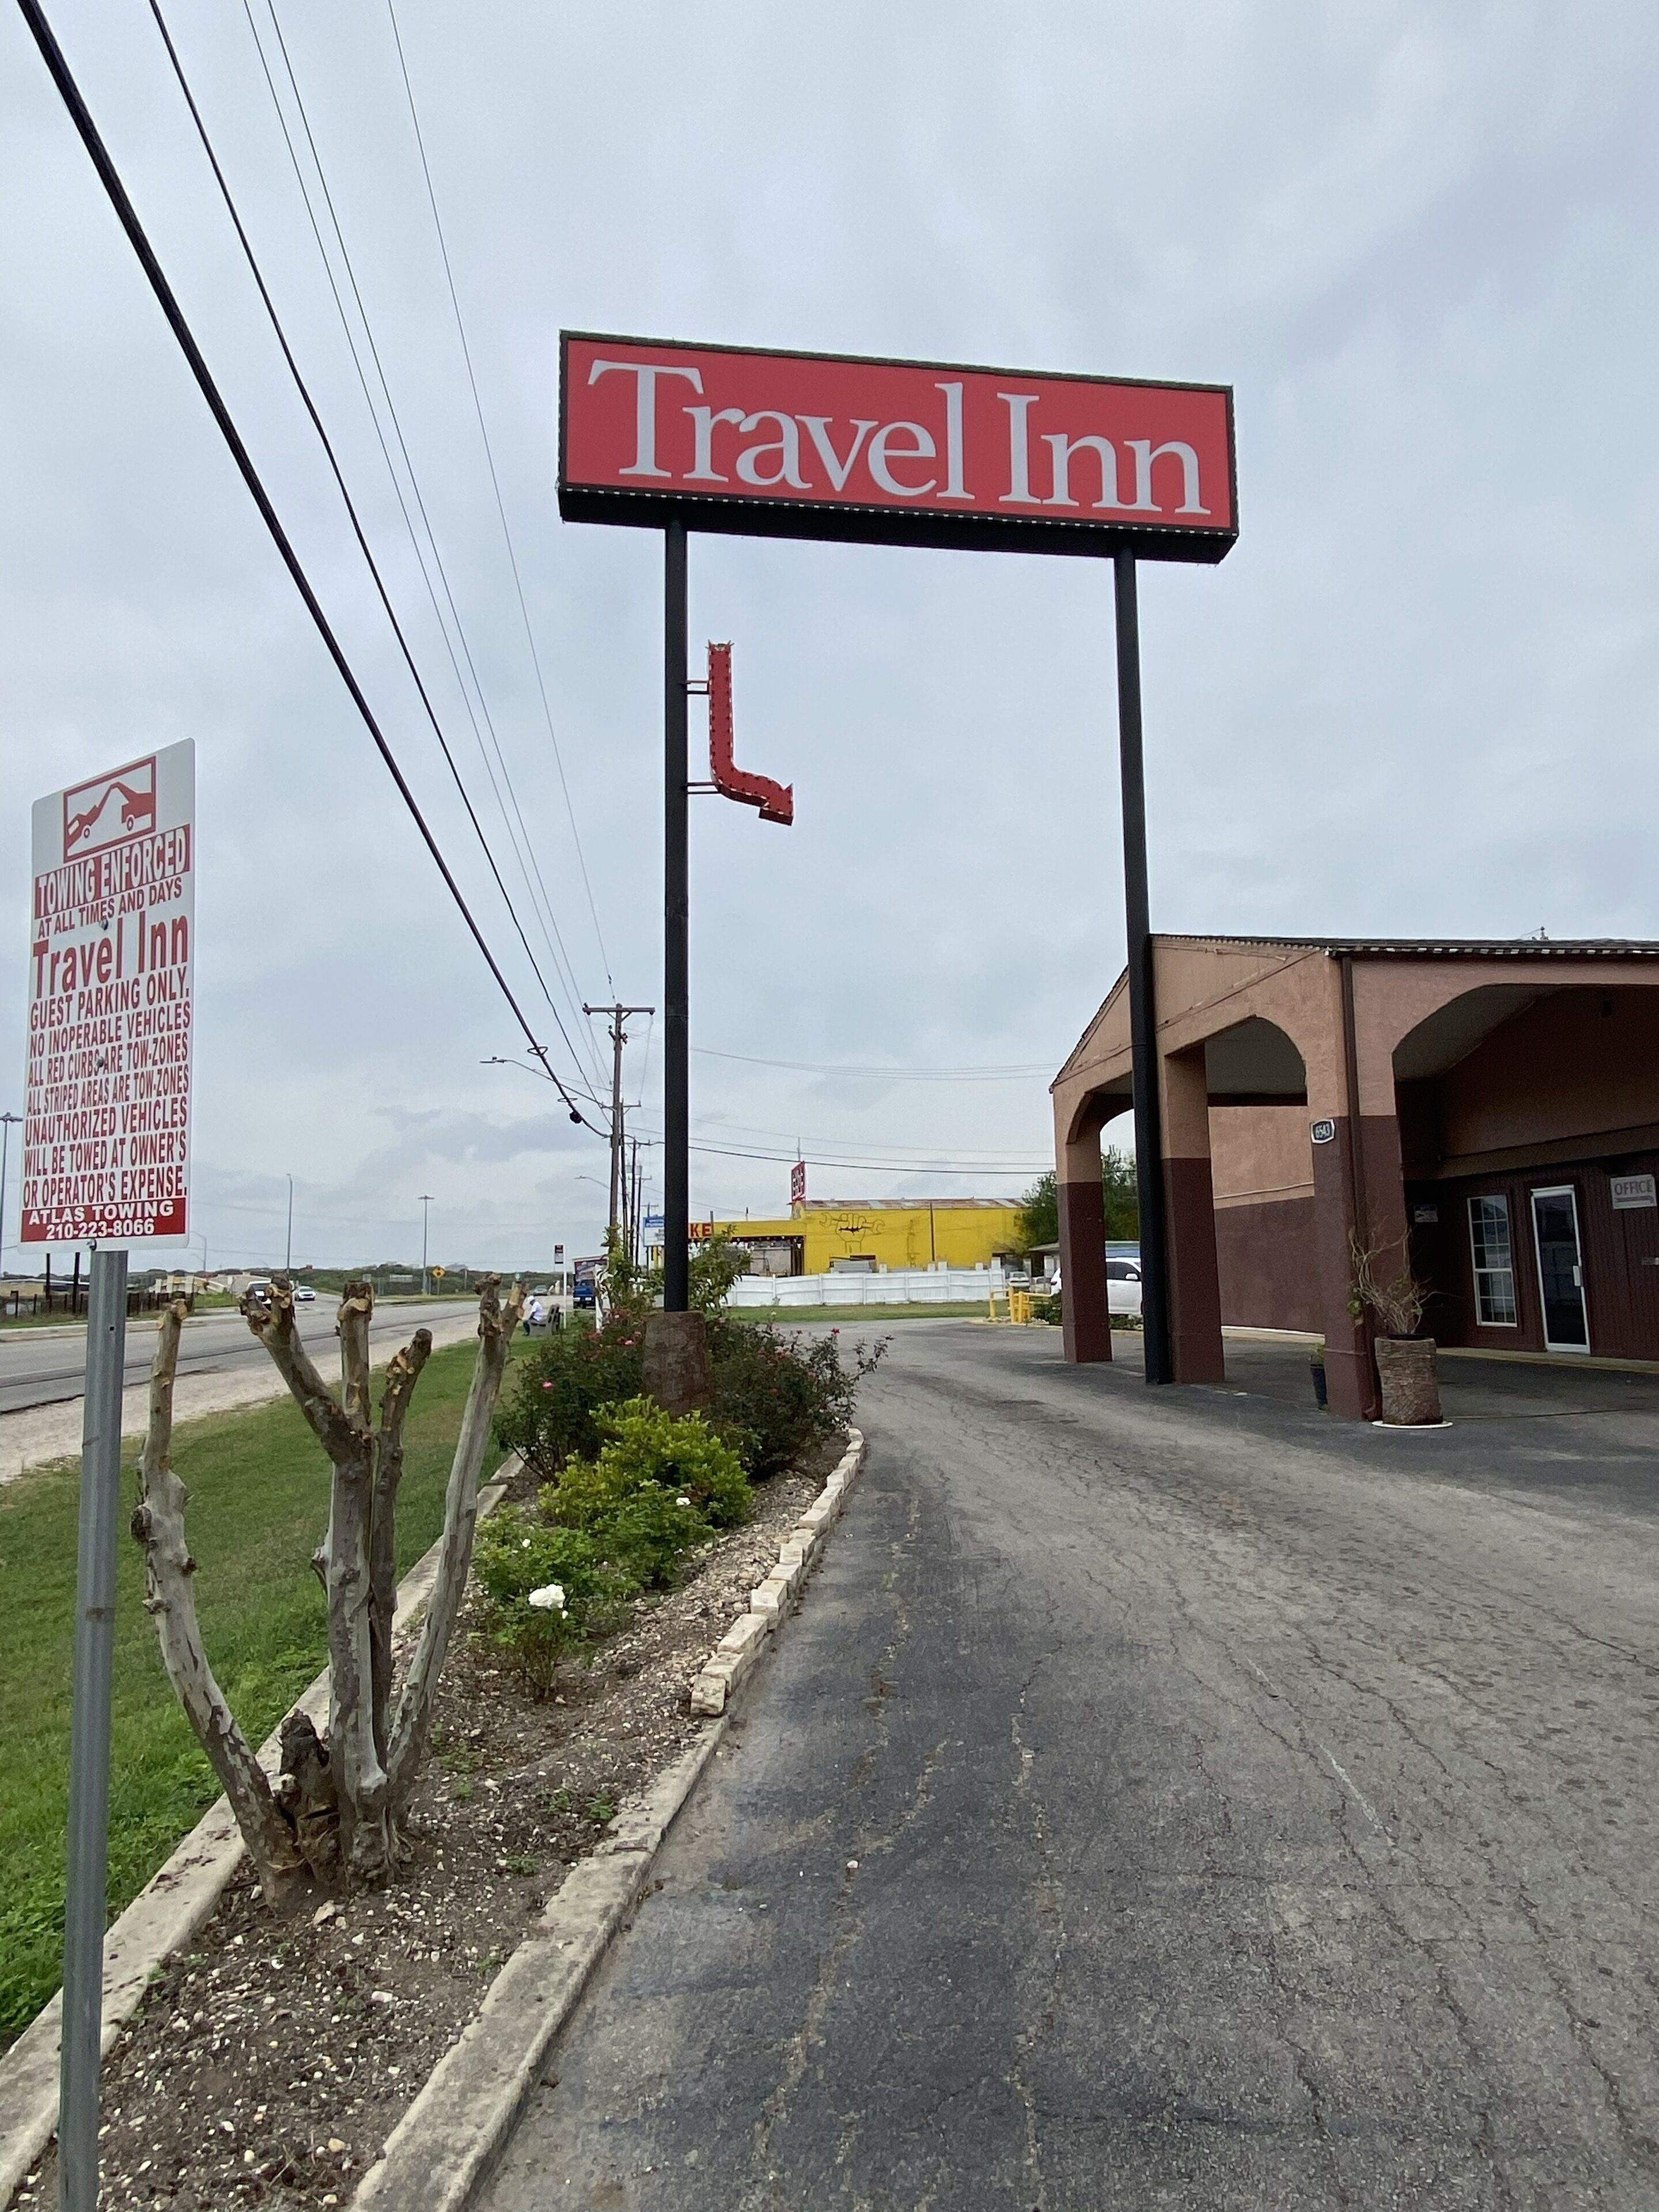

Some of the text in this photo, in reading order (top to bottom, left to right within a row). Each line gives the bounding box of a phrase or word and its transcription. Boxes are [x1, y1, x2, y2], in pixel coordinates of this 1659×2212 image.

[586, 359, 1211, 514] Travel Inn
[39, 827, 186, 916] TOWING ENFORCED
[37, 877, 182, 940] AT ALL TIMES AND DAYS
[33, 911, 188, 998] Travel Inn
[31, 966, 189, 1031] GUEST PARKING ONLY.
[30, 1001, 190, 1059] NO INOPERABLE VEHICLES
[28, 1032, 188, 1088] ALL RED CURBS ARE TOW-ZONES
[28, 1064, 189, 1116] ALL STRIPED AREAS ARE TOW-ZONES
[25, 1096, 187, 1146] UNAUTHORIZED VEHICLES
[24, 1130, 186, 1177] WILL BE TOWED AT OWNER'S
[24, 1165, 187, 1208] OR OPERATOR'S EXPENSE.
[29, 1200, 173, 1225] ATLAS TOWING
[1615, 1179, 1653, 1195] OFFICE
[46, 1218, 154, 1239] 210-223-8066
